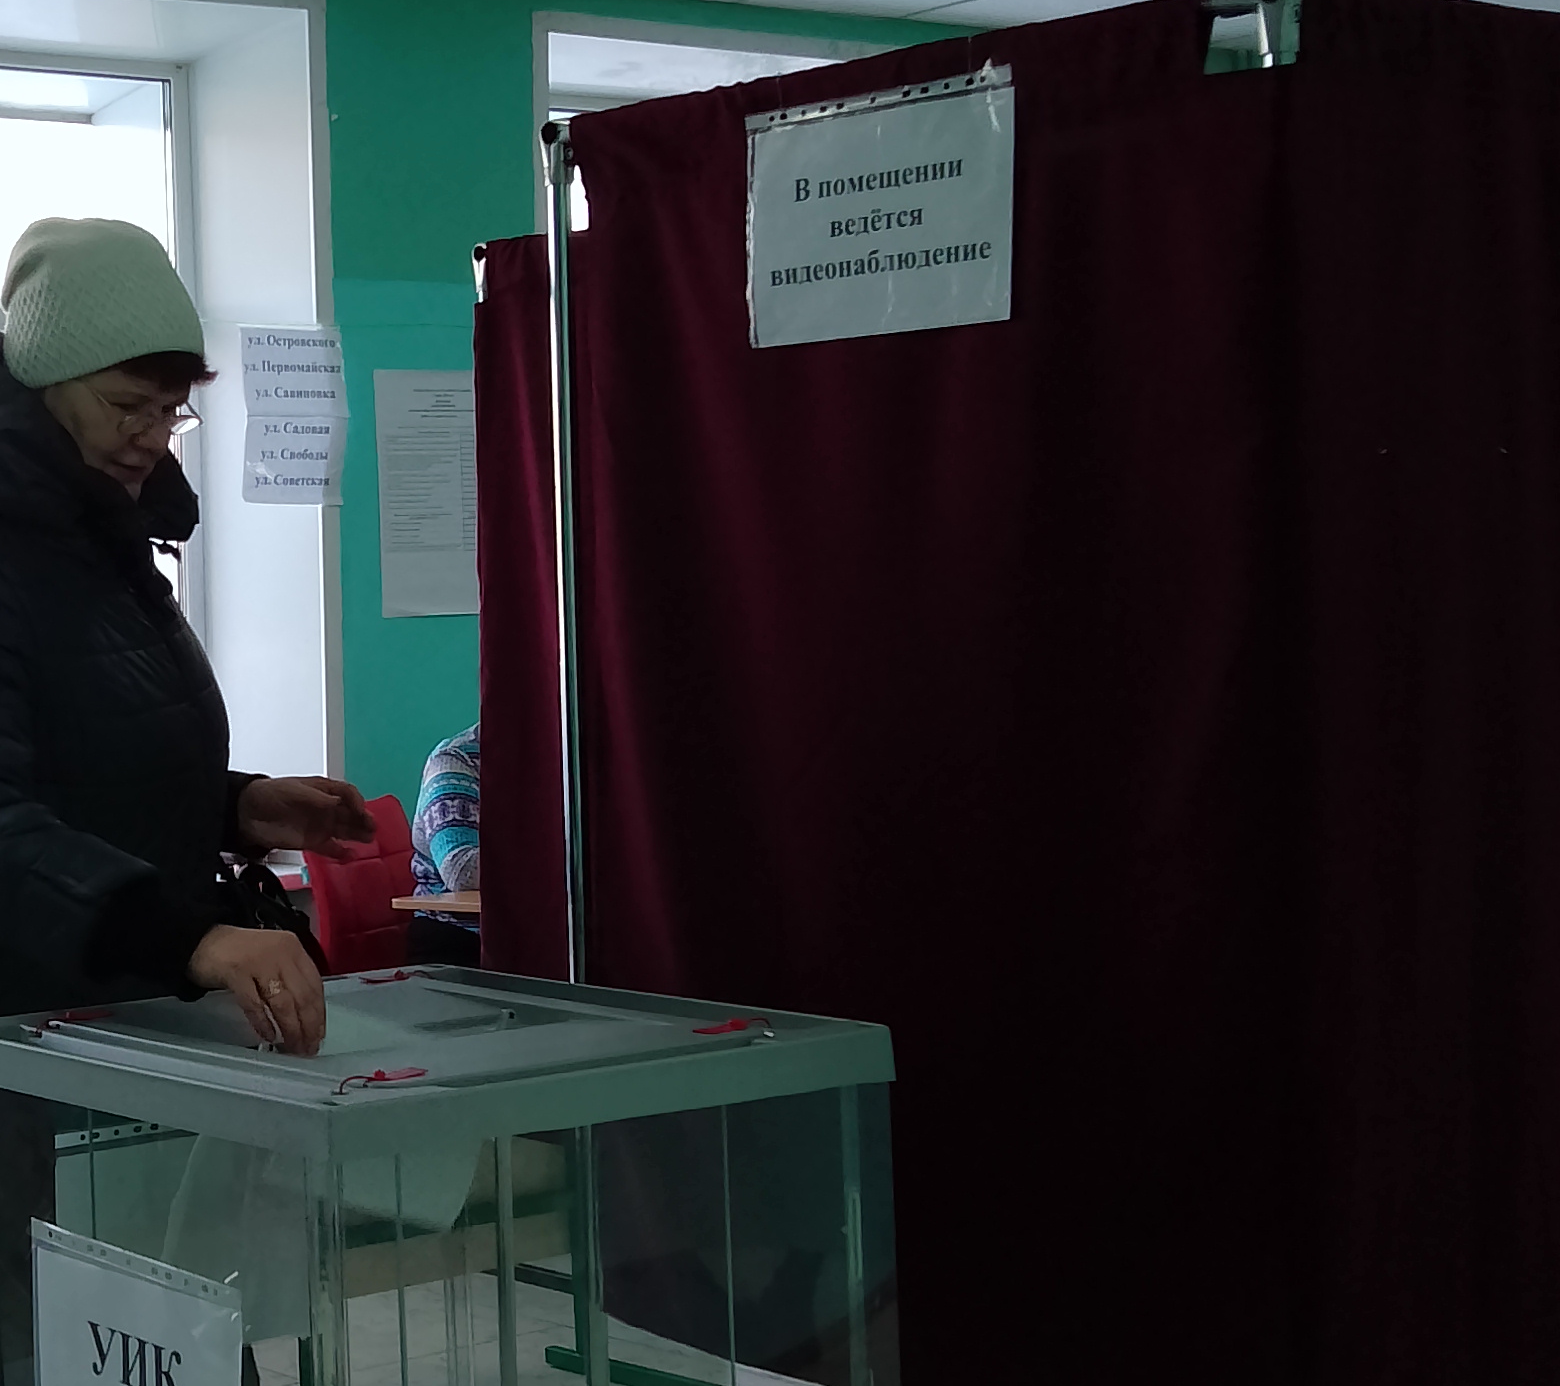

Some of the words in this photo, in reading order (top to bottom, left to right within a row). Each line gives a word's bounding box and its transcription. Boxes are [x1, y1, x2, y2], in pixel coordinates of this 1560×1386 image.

[794, 178, 811, 203] В
[818, 159, 963, 199] помещении
[830, 207, 924, 238] ведётся
[770, 240, 992, 288] видеонаблюдение
[266, 334, 336, 349] Островского
